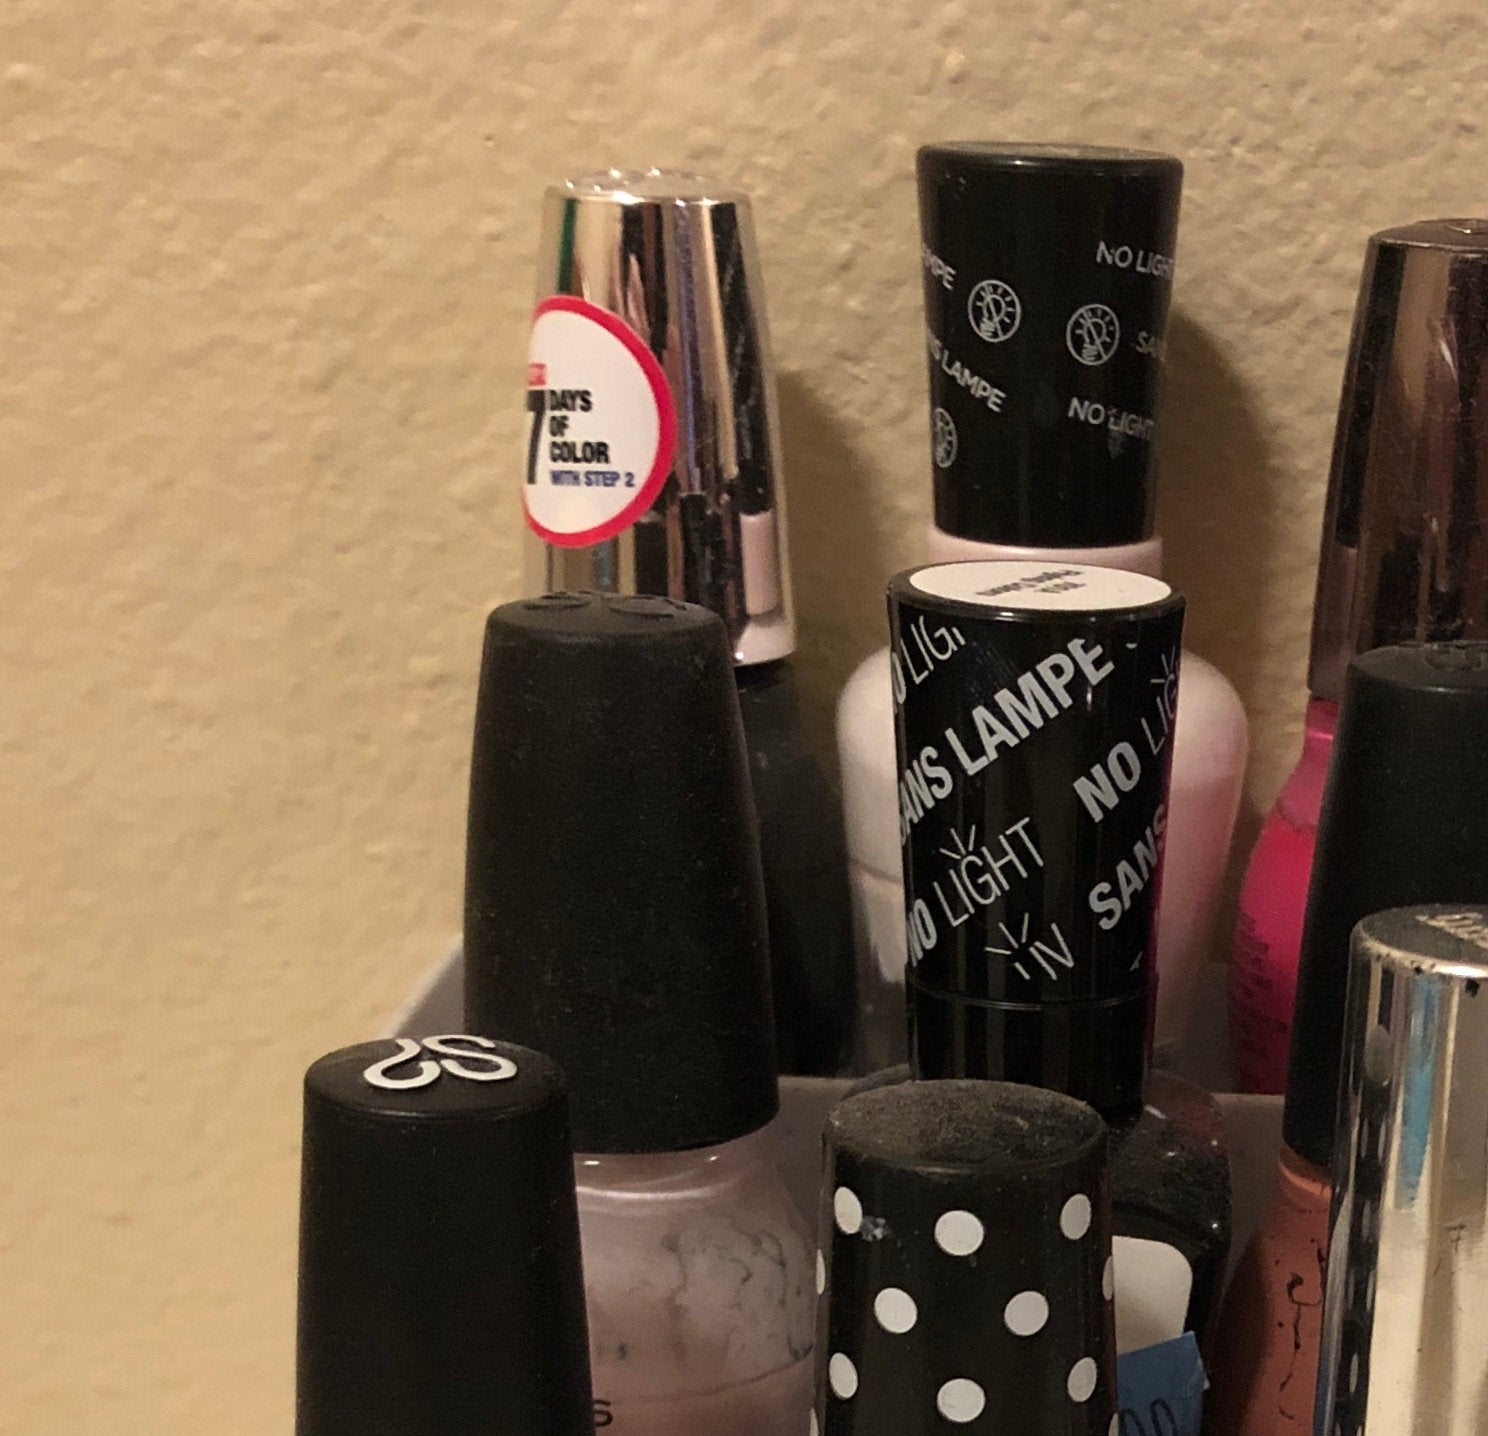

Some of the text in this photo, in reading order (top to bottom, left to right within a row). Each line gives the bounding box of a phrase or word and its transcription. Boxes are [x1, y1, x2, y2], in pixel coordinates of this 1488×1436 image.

[1096, 241, 1134, 268] NO
[941, 348, 1008, 413] LAMPE
[549, 415, 569, 437] OF
[1068, 397, 1105, 425] NO
[527, 390, 545, 484] 7
[549, 389, 593, 412] DAYS
[550, 441, 611, 464] COLOR
[584, 470, 621, 487] STEP
[624, 472, 636, 488] 2
[945, 638, 1116, 776] LAMPE
[1073, 741, 1142, 823] NO
[934, 816, 1044, 928] LIGHT
